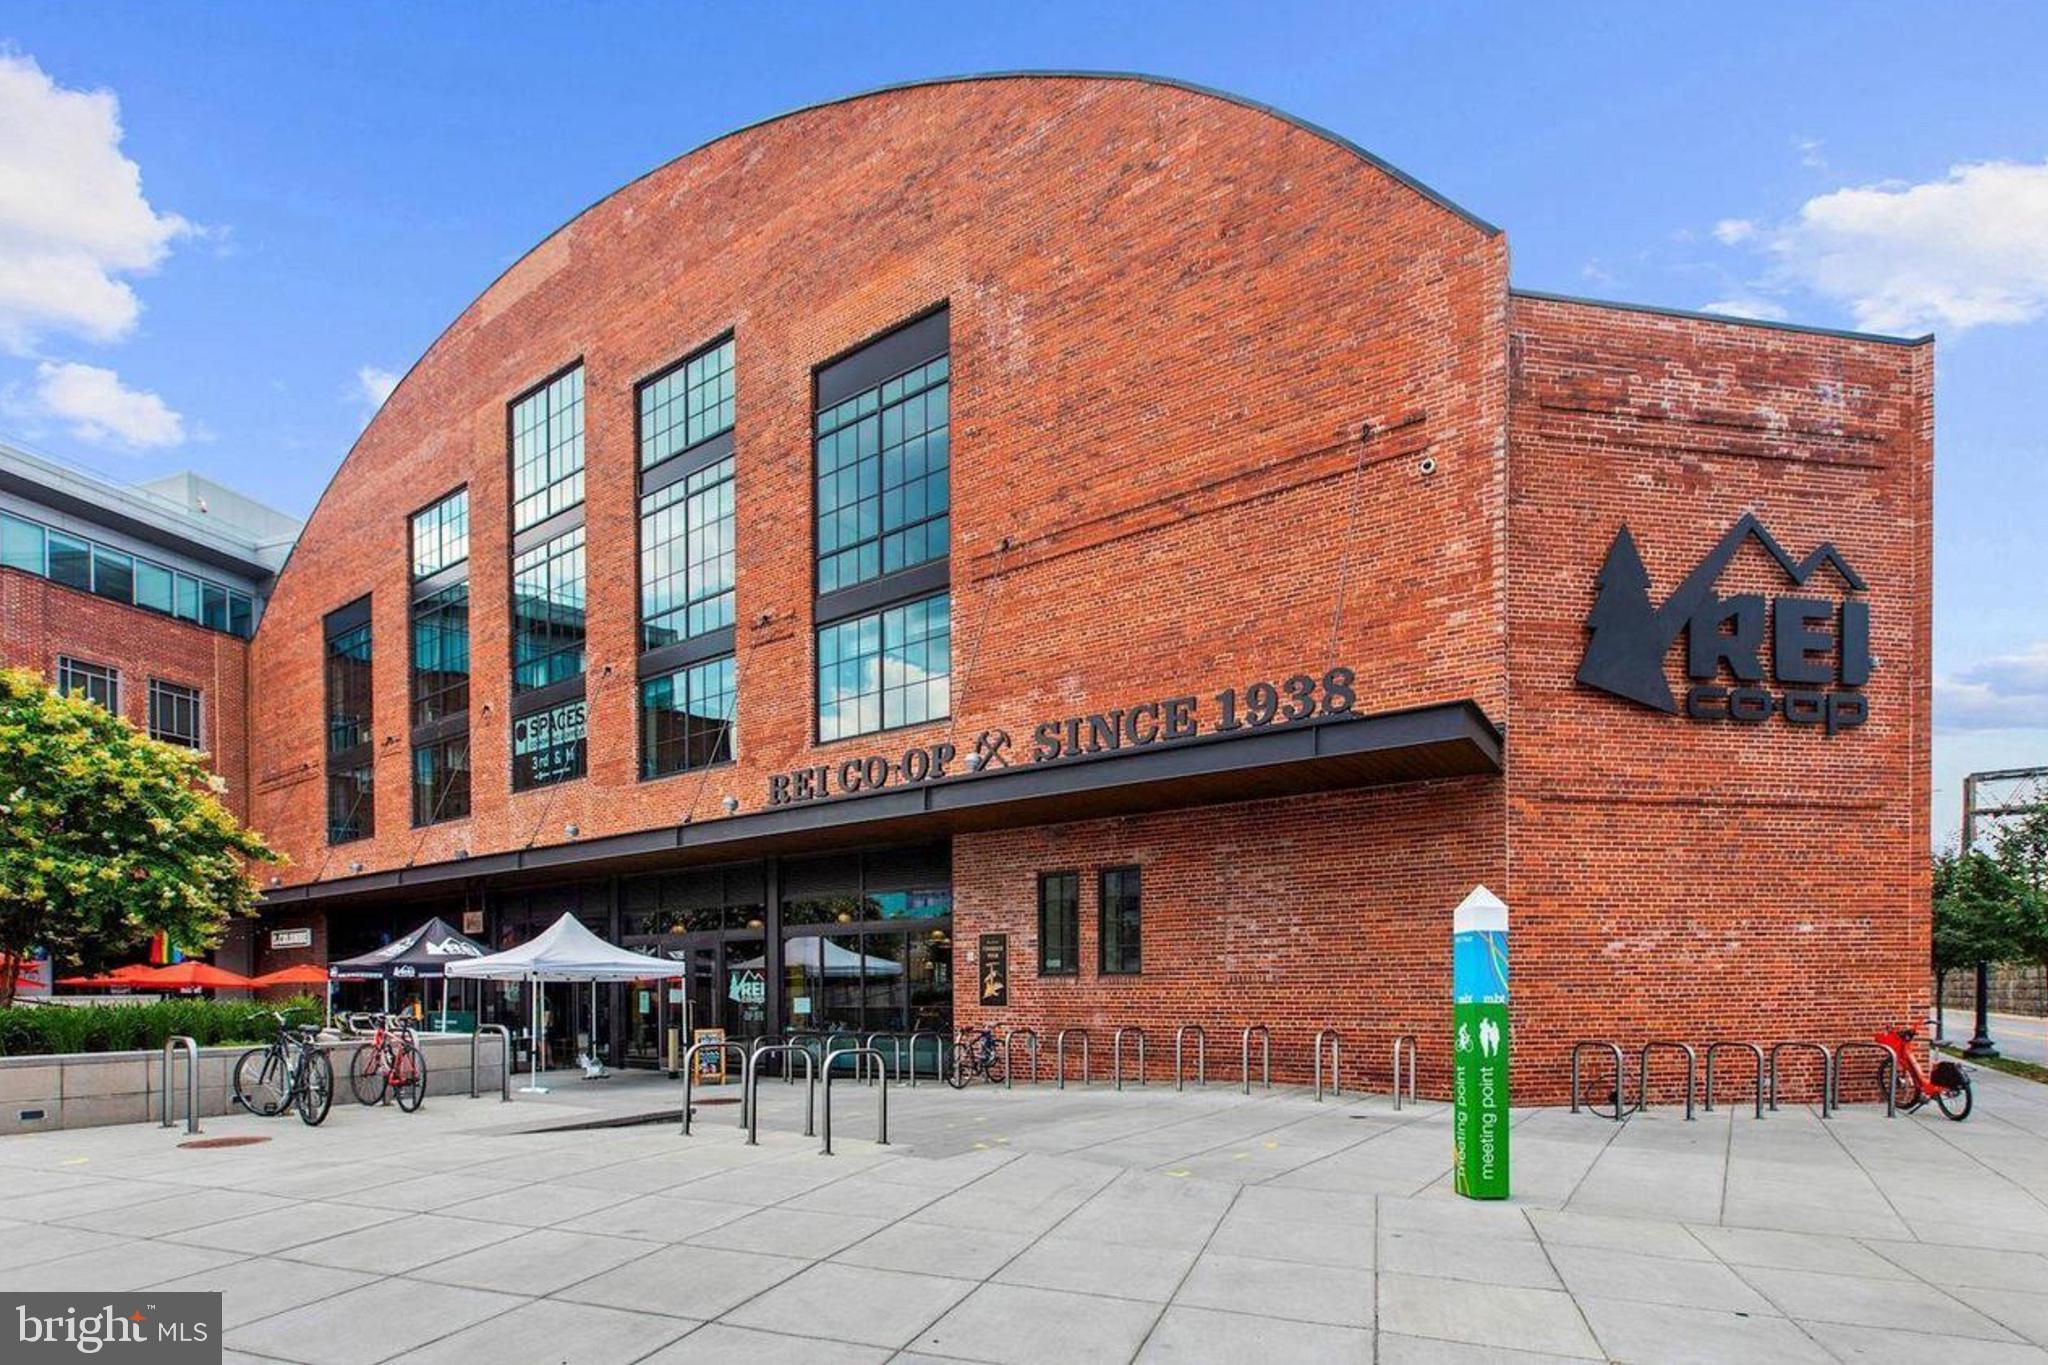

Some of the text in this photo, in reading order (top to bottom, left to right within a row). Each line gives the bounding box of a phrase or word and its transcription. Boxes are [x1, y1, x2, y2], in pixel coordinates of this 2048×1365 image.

[1687, 592, 1869, 686] REI
[530, 704, 585, 738] SPACES
[768, 765, 830, 806] REI
[1033, 696, 1197, 762] SINCE
[1215, 666, 1358, 732] 1938
[741, 982, 765, 996] REI
[1456, 1066, 1468, 1106] point
[1480, 1066, 1498, 1180] meeting point
